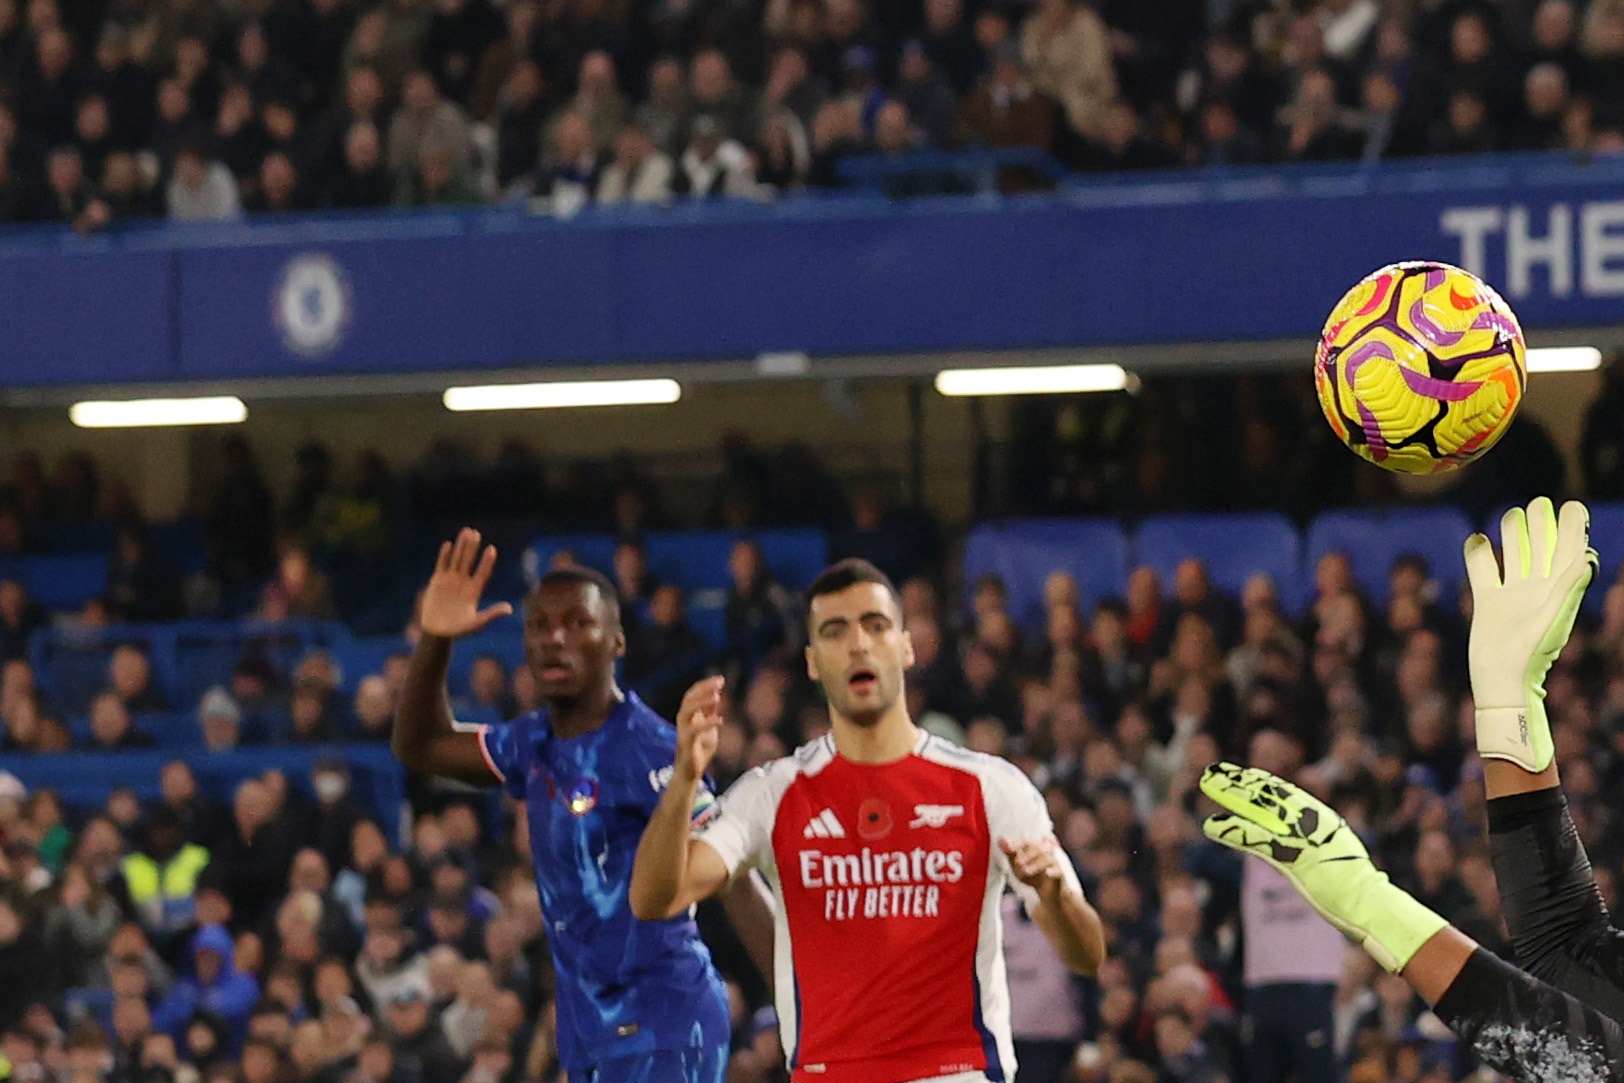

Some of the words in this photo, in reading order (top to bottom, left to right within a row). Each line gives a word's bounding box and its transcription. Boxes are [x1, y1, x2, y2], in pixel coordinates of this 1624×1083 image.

[799, 847, 964, 889] Emirates
[825, 889, 857, 921] FLY
[864, 885, 939, 918] BETTER
